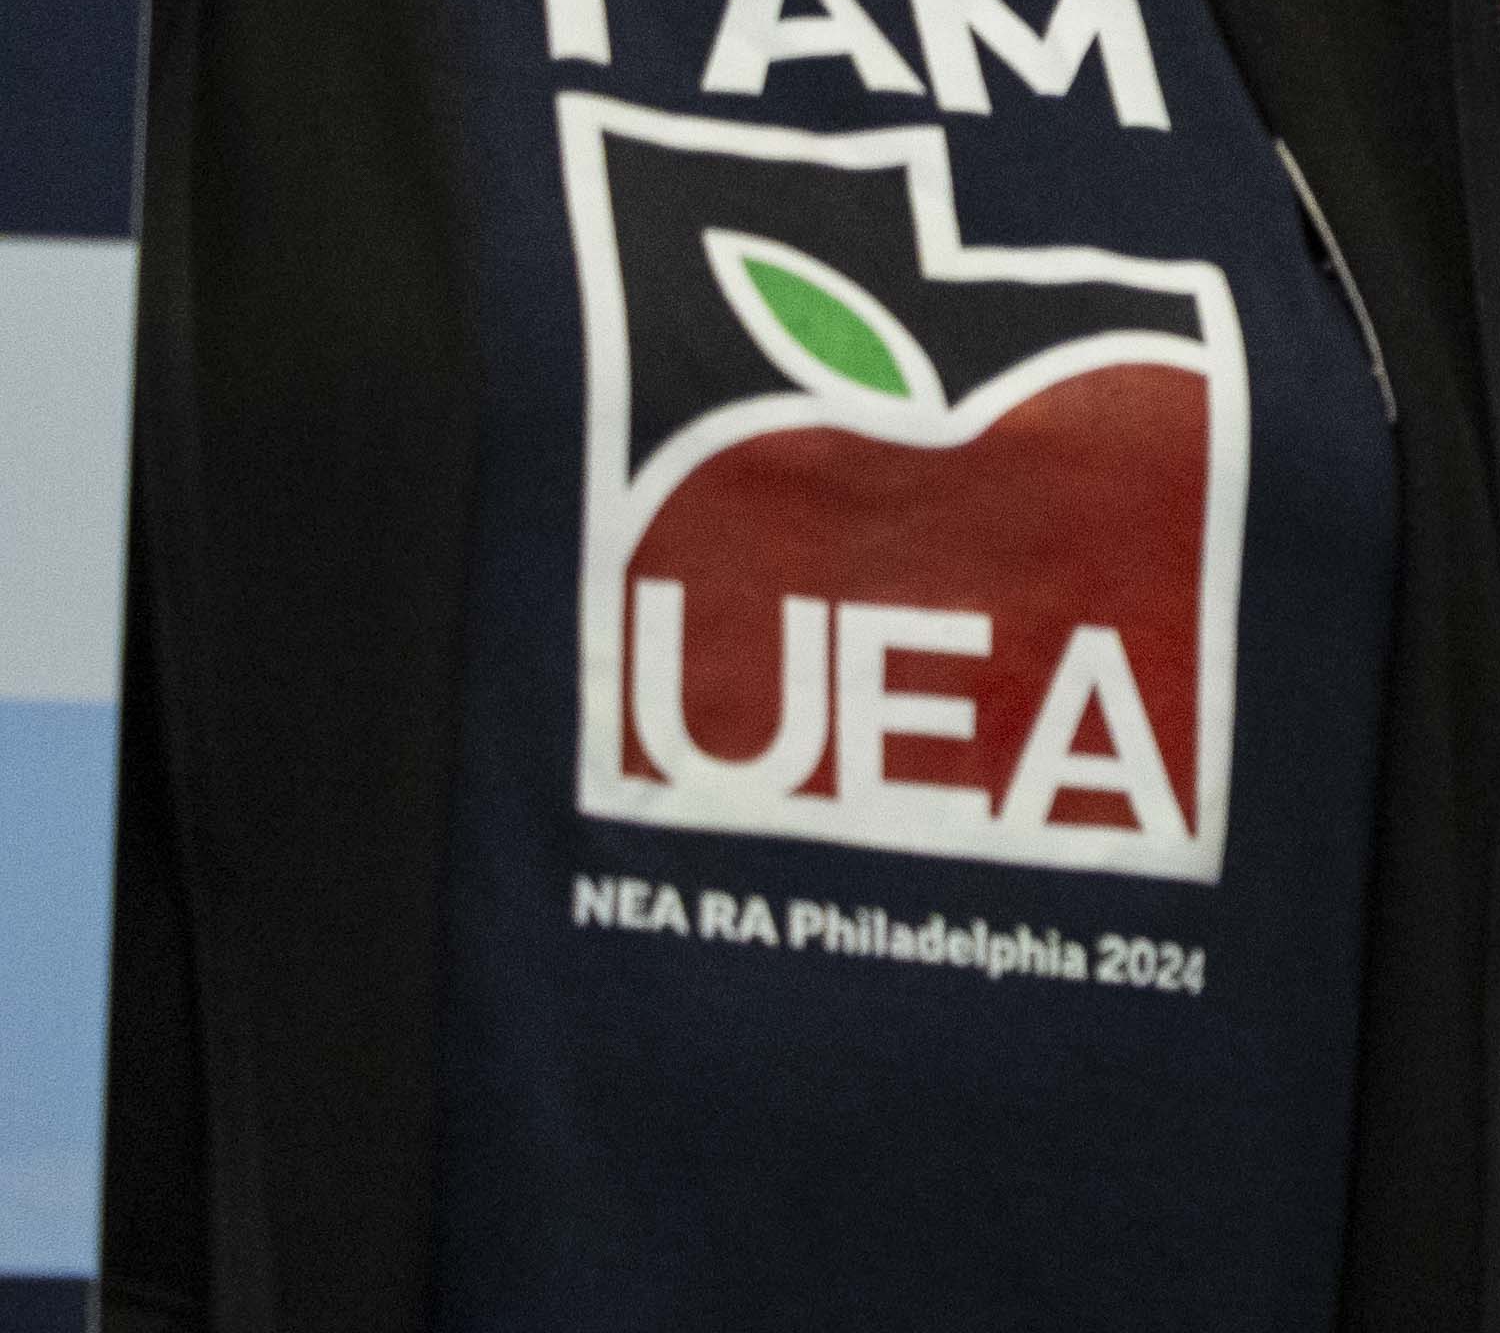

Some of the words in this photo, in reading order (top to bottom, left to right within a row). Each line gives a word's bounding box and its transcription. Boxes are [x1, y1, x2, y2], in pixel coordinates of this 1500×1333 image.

[629, 579, 1196, 839] UEA
[572, 874, 690, 938] NEA
[699, 888, 780, 948] RA
[787, 899, 1089, 980] Philadelphia
